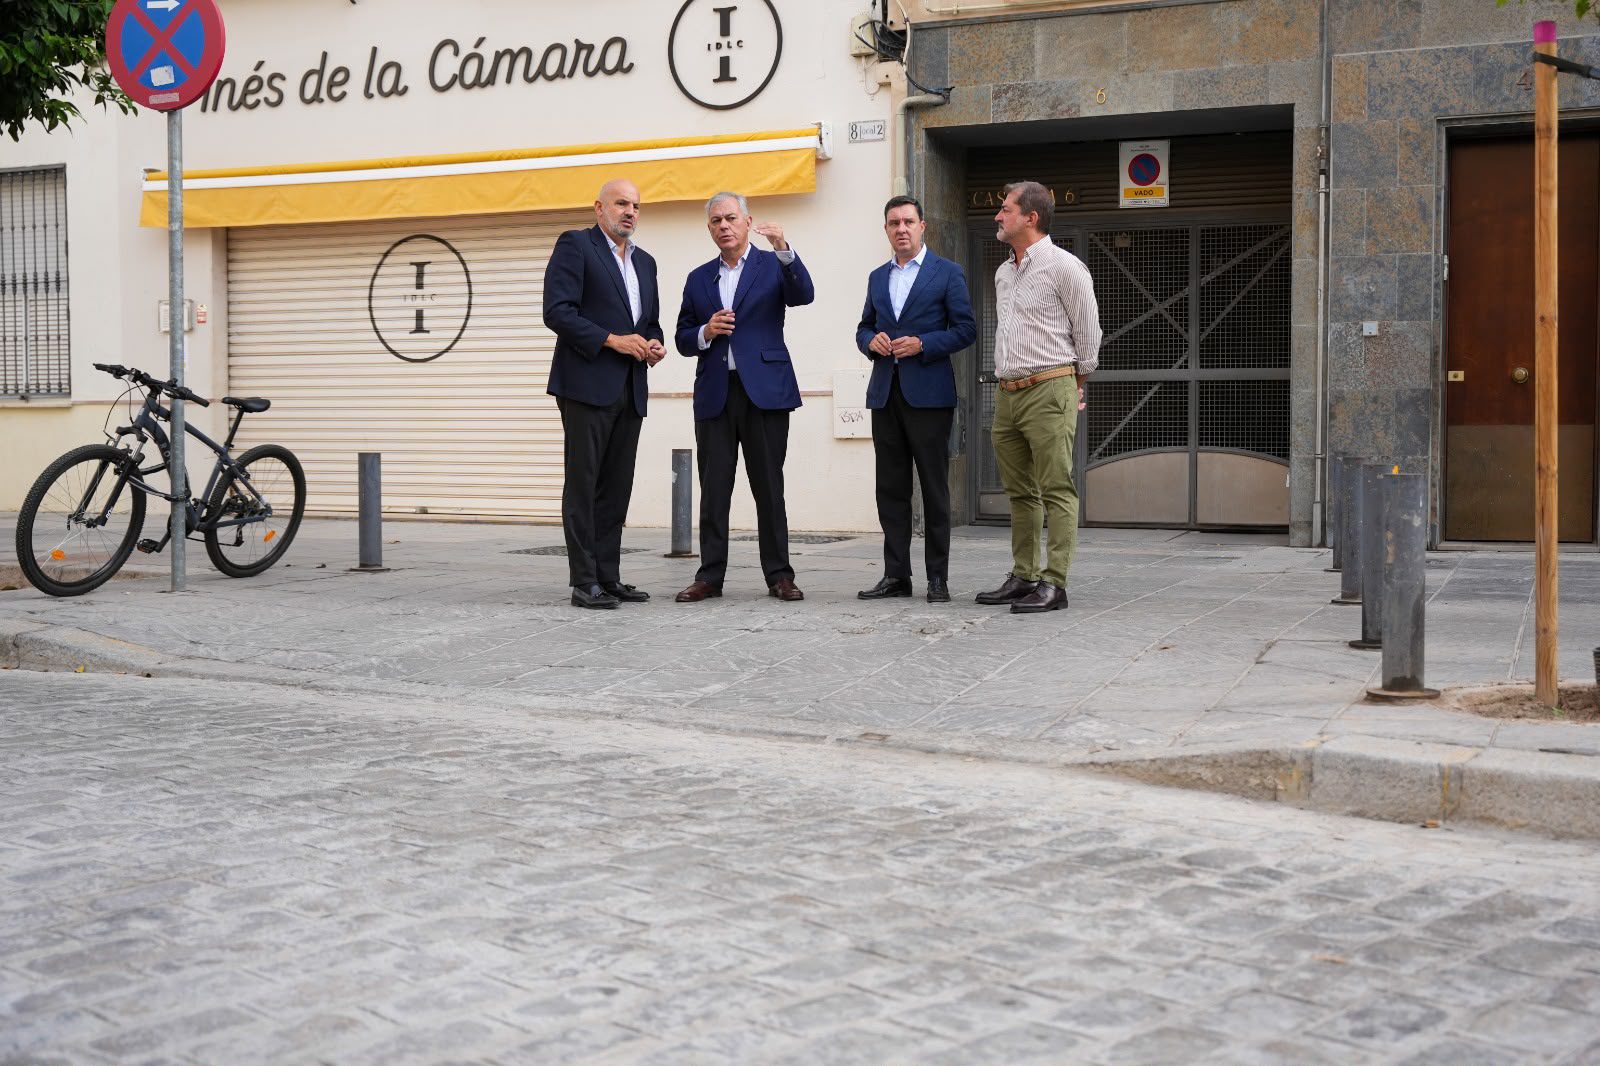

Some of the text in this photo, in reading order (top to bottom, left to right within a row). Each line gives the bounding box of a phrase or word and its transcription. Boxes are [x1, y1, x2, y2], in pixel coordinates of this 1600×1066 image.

[707, 39, 744, 52] IDLC
[299, 50, 350, 105] de
[363, 45, 408, 99] la
[428, 35, 635, 94] Cámara
[1096, 87, 1107, 104] 6
[850, 123, 858, 140] 8
[877, 124, 883, 135] 2
[1065, 187, 1075, 204] 6
[1134, 189, 1154, 197] VADO
